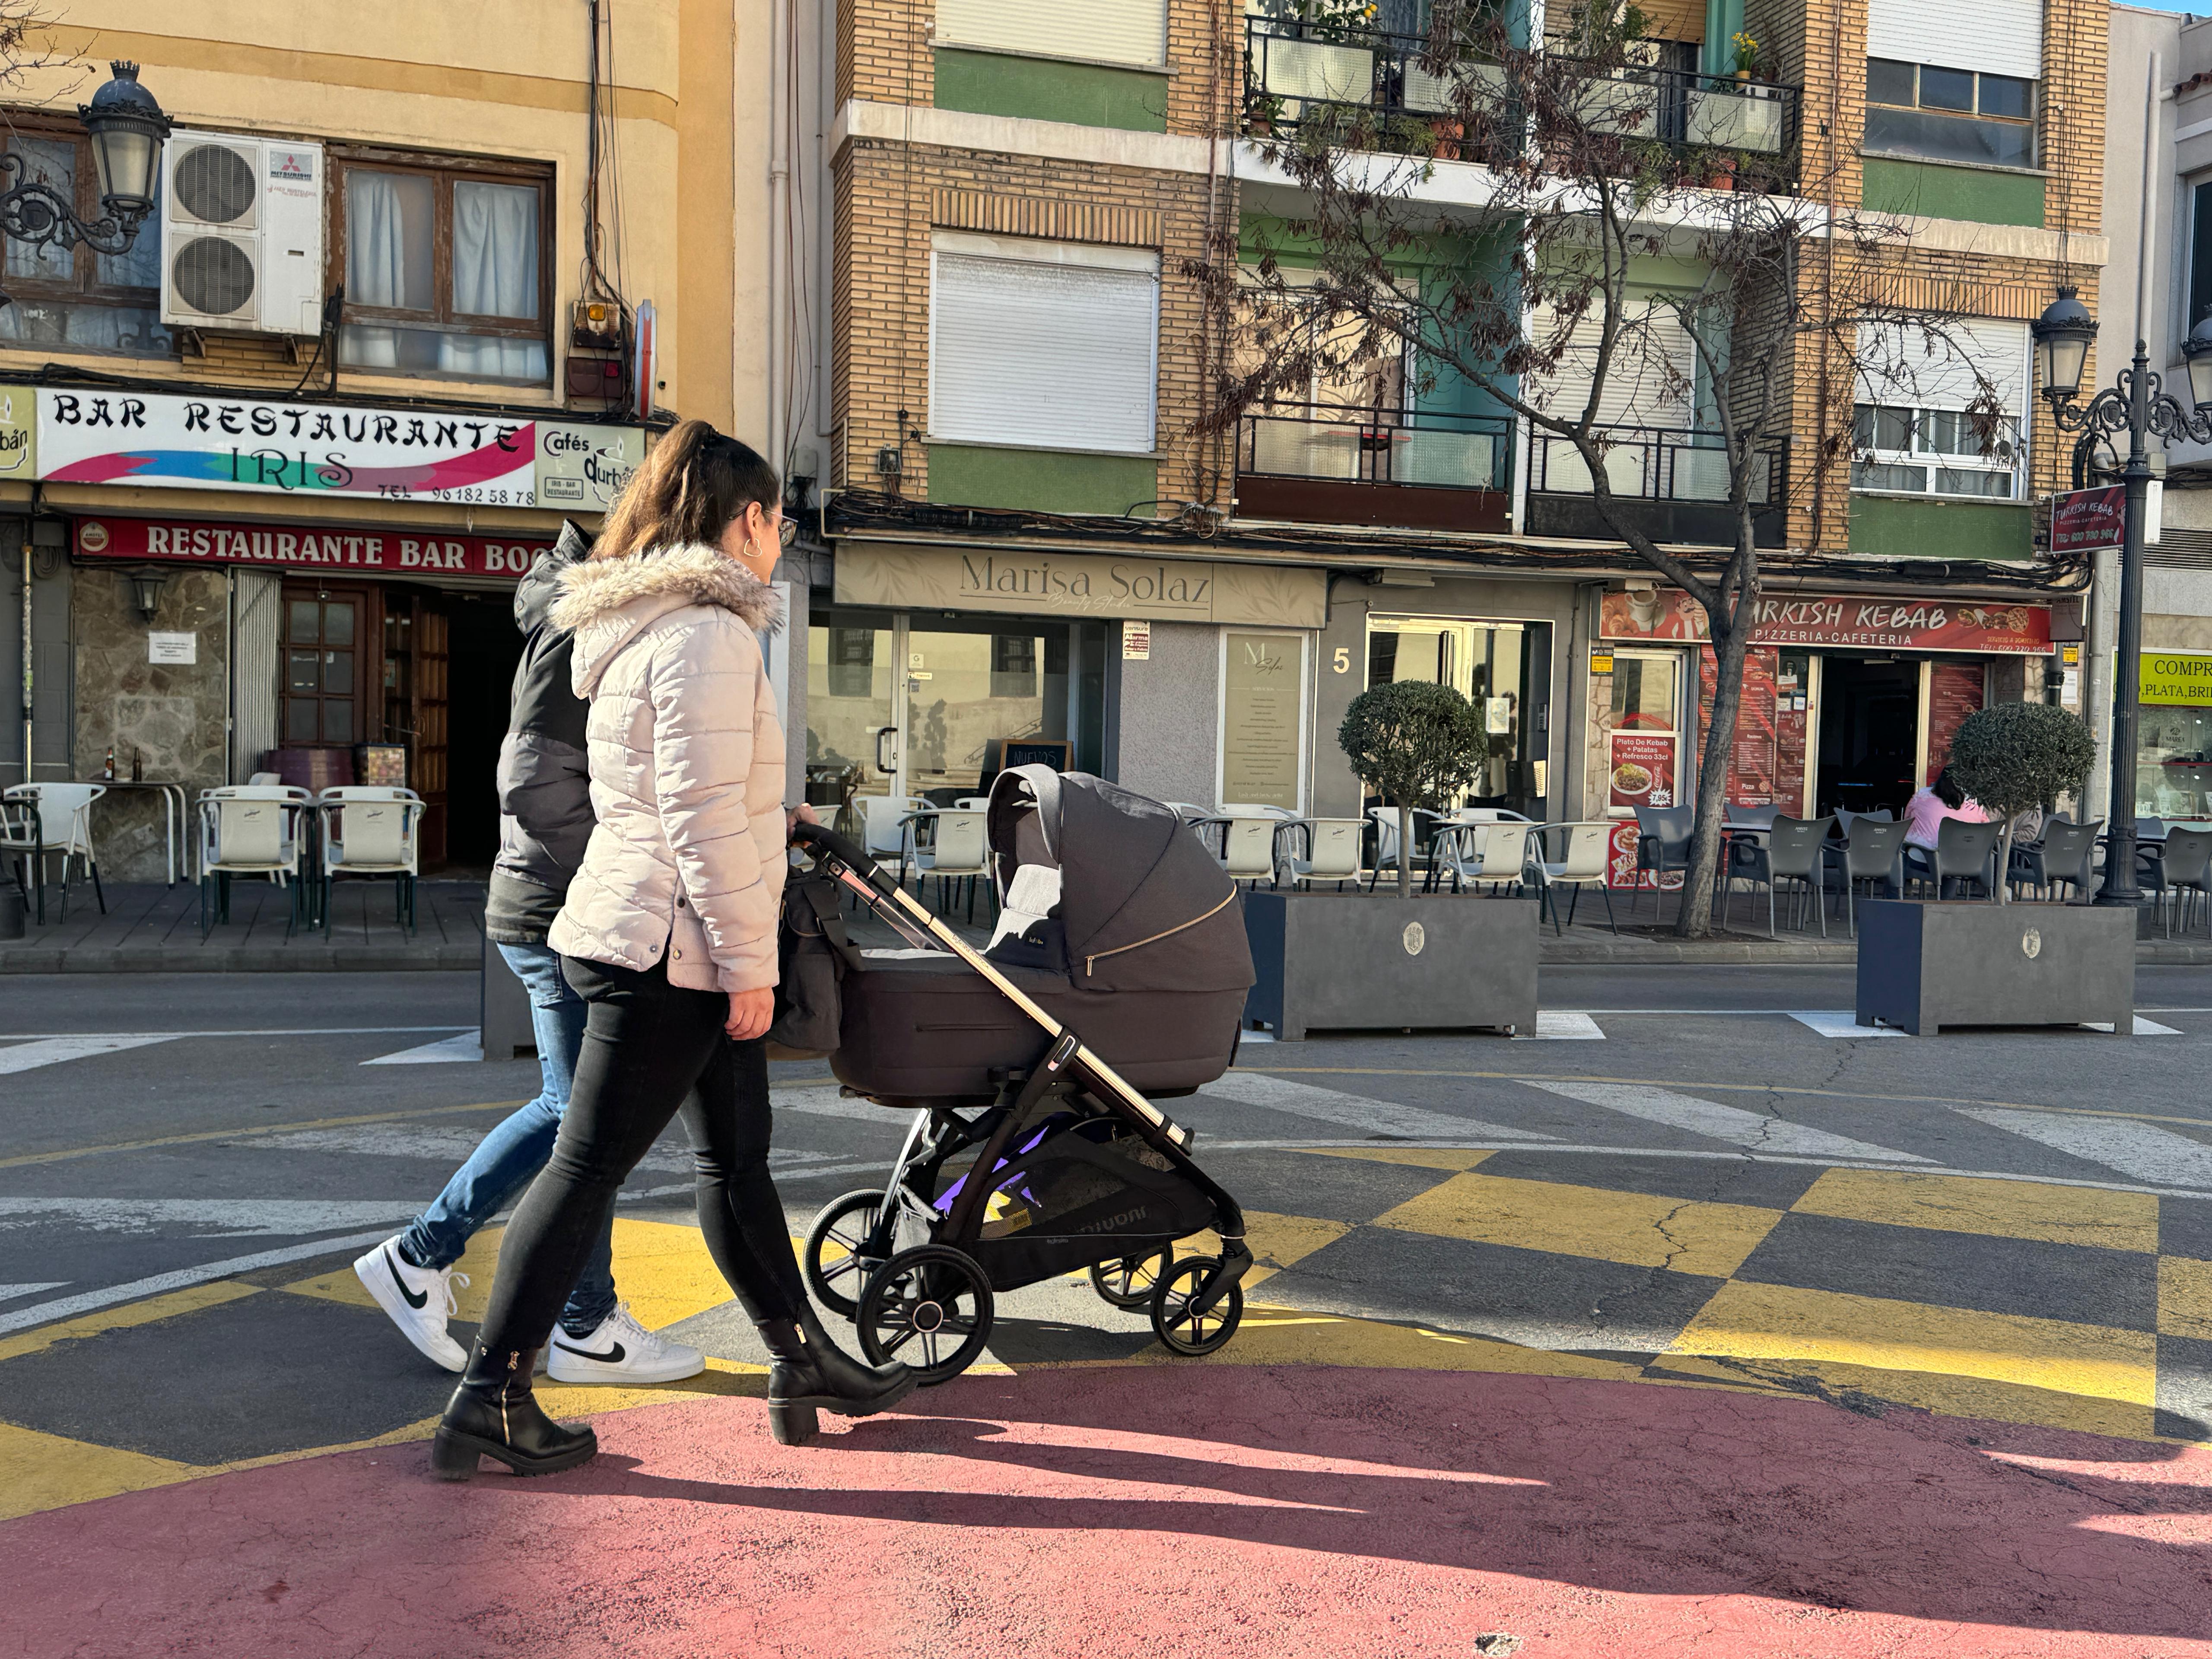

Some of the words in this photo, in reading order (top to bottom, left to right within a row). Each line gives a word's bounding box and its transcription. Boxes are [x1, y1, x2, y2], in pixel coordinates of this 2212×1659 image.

[53, 394, 146, 429] BAR
[184, 402, 520, 453] RESTAURANTE
[543, 431, 589, 457] Cafés
[231, 447, 353, 490] IRIS
[584, 453, 636, 486] durb
[378, 484, 411, 498] TEL
[489, 490, 508, 504] 58
[516, 491, 534, 505] 78
[547, 488, 580, 497] RESTAURANTE
[2056, 502, 2086, 523] TURKISH
[2089, 502, 2113, 516] KEBAB
[147, 526, 383, 564] RESTAURANTE
[400, 540, 465, 569] BAR
[960, 555, 1092, 597] Marisa
[1109, 564, 1210, 603] Solaz
[1047, 592, 1091, 611] Beauty
[1094, 594, 1131, 612] Studio
[1729, 597, 1843, 627] RKISH
[1856, 604, 1948, 629] KEBAB
[1755, 629, 1912, 645] PIZZERIA-CAFETERIA
[1243, 642, 1265, 664] M
[1334, 648, 1349, 673] 5
[1014, 750, 1056, 766] NUEVOS
